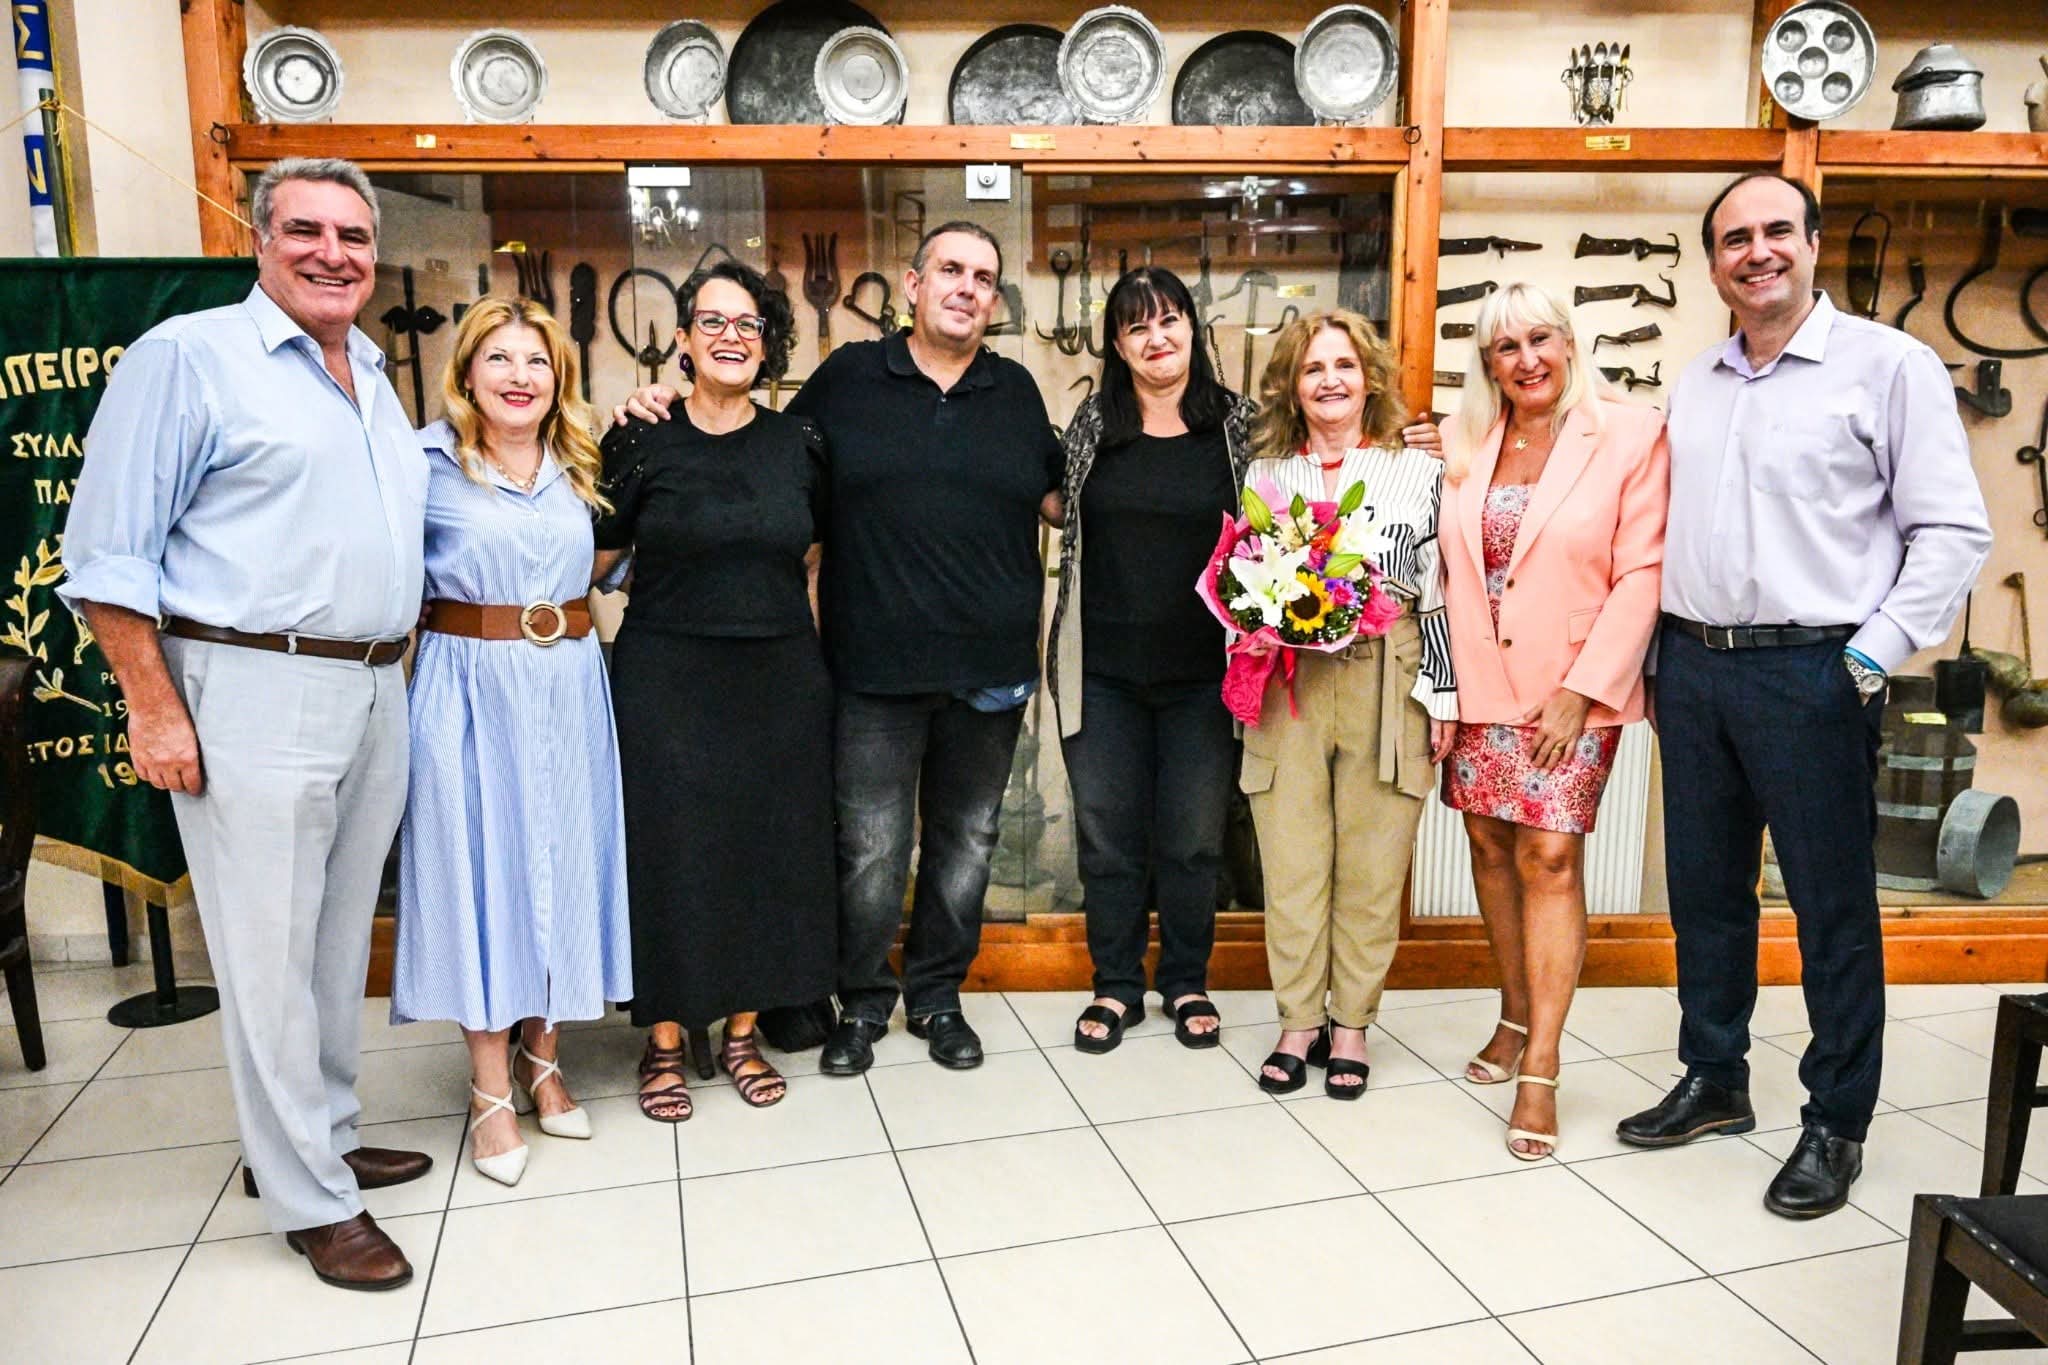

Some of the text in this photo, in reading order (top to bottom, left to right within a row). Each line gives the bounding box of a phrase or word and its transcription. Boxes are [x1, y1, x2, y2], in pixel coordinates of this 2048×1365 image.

[0, 346, 125, 400] ΠΕΙΡΩ
[10, 432, 86, 458] ΣΥΛΛ
[97, 761, 138, 789] 19
